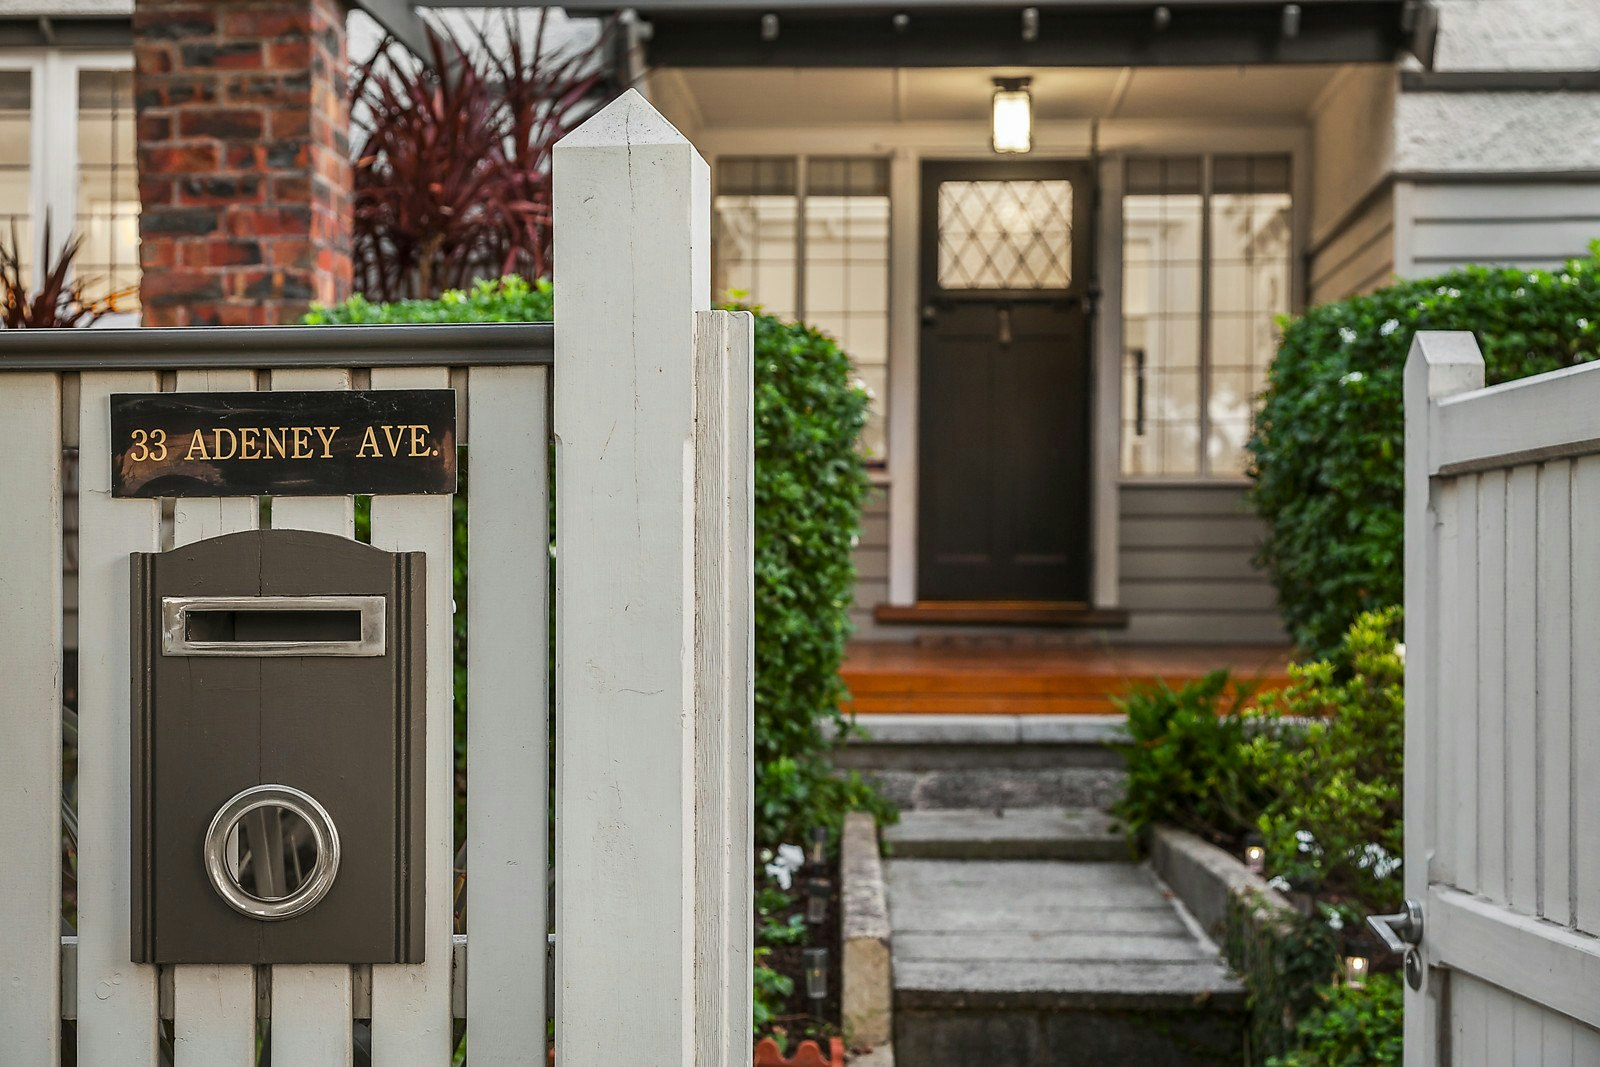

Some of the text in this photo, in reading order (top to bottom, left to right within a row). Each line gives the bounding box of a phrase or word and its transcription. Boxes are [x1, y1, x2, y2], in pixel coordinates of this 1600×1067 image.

[130, 424, 439, 462] 33 ADENEY AVE.
